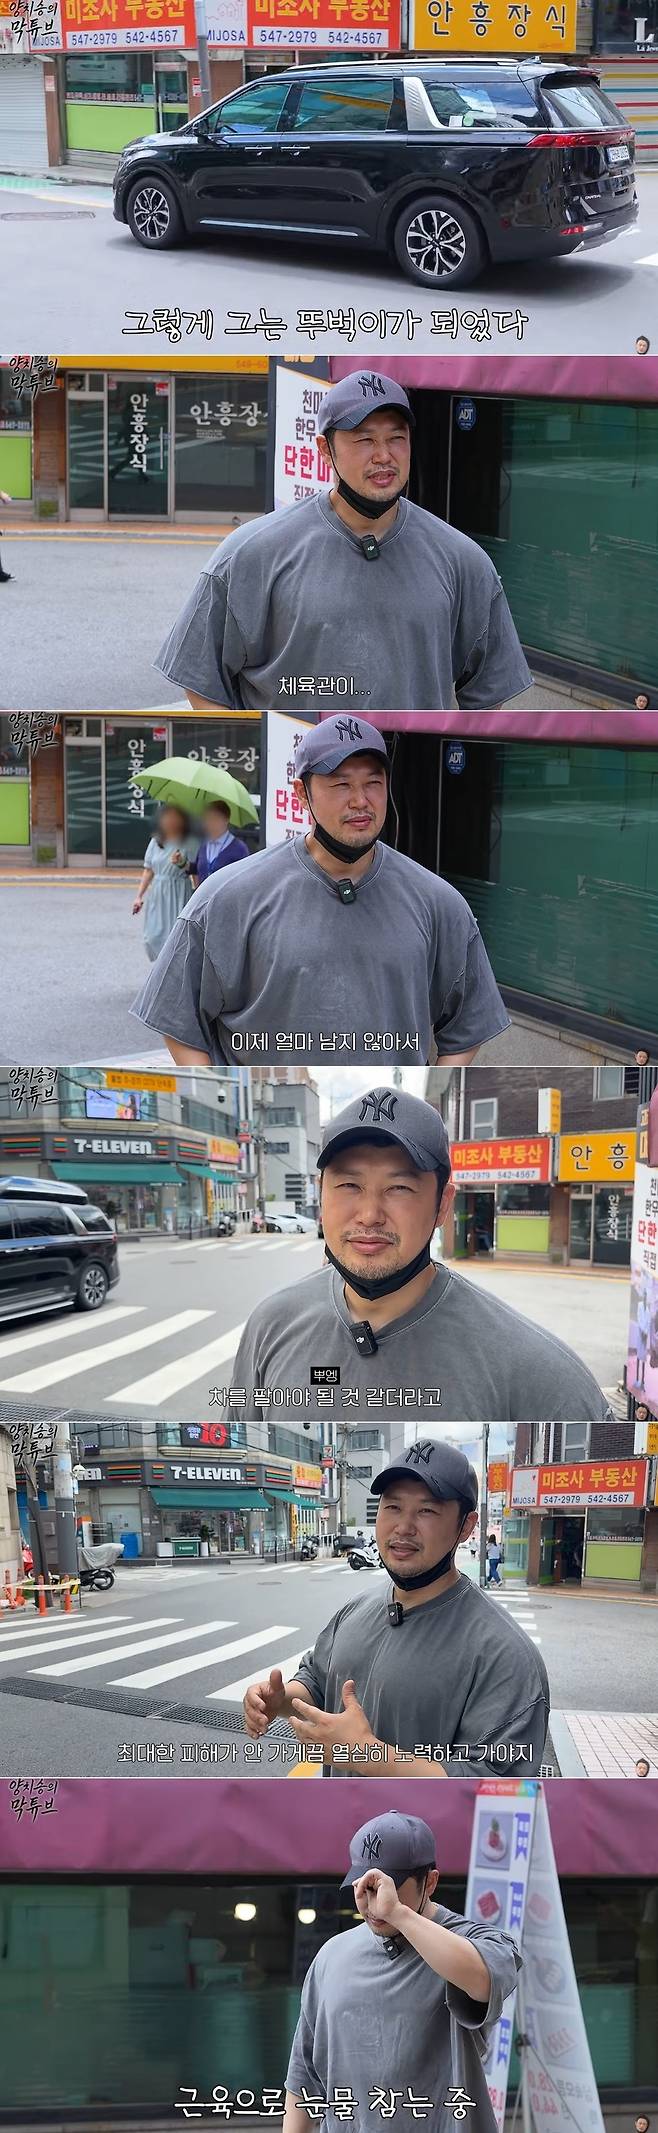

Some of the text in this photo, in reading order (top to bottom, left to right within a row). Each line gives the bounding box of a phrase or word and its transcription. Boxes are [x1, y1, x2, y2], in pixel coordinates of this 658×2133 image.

[71, 29, 178, 46] 547-2979 542-4567
[260, 30, 382, 44] 547-2979 542-4567
[358, 374, 386, 398] NY
[190, 401, 268, 427] 안흥장
[129, 393, 149, 473] 안흥장식
[295, 417, 316, 442] 한우
[334, 718, 363, 742] NY
[358, 1091, 399, 1122] NY
[453, 1145, 542, 1167] 미조사 부동산
[405, 1441, 436, 1464] NY
[542, 1466, 638, 1490] 미조사 부동산
[543, 1494, 629, 1504] 547-2979 542-4567
[361, 1832, 383, 1860] NY
